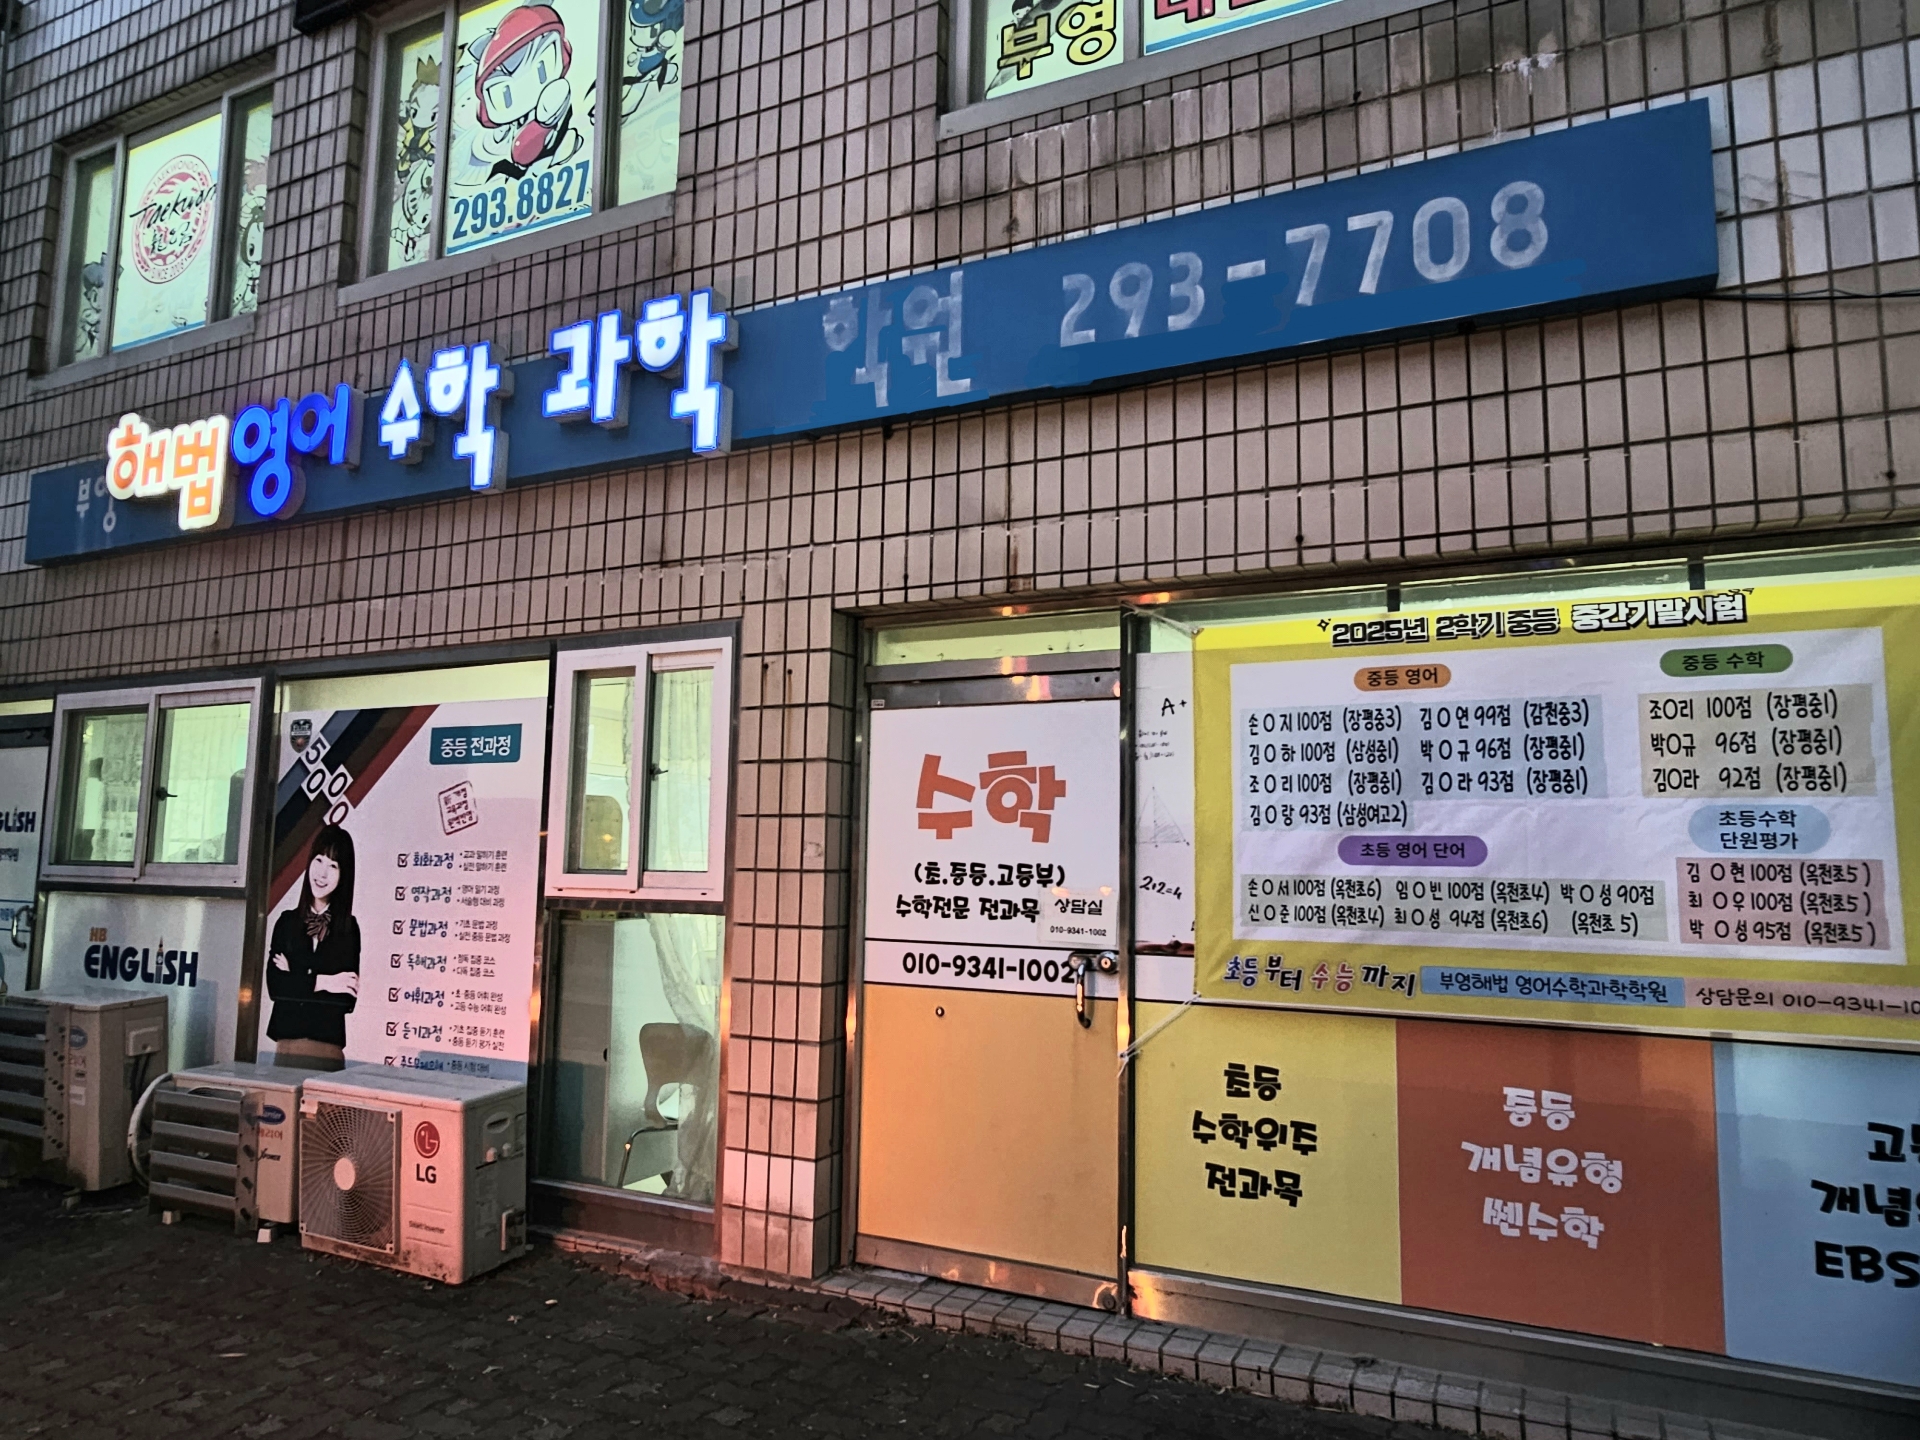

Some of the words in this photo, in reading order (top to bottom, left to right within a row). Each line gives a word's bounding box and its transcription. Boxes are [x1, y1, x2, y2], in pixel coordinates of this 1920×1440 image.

[998, 0, 1116, 81] 부영
[453, 160, 590, 240] 293.8827
[378, 341, 500, 490] 수학
[543, 288, 726, 454] 과학
[1059, 180, 1549, 349] 293-7708
[1332, 618, 1429, 647] 2025년
[1570, 593, 1748, 632] 중간기말시험
[1682, 654, 1718, 671] 중등
[1726, 651, 1765, 669] 수학
[1367, 670, 1399, 687] 중등
[1405, 668, 1438, 685] 영어
[1524, 699, 1589, 728] (감천중3)
[1707, 696, 1752, 719] 100점
[1767, 689, 1837, 721] (장평중1)
[1343, 705, 1401, 733] (장평중3)
[441, 738, 466, 758] 중등
[471, 736, 511, 757] 전과정
[1347, 737, 1399, 764] (삼성중1)
[1524, 732, 1584, 762] (장평중1)
[1715, 731, 1756, 754] 96점
[1772, 725, 1842, 756] (장평중1)
[1348, 769, 1401, 795] (장평중1)
[1527, 766, 1588, 795] (장평중1)
[1719, 767, 1761, 790] 92점
[1776, 761, 1847, 792] (장평중1)
[916, 751, 1066, 843] 수학
[1337, 800, 1407, 828] (삼성여고2)
[1719, 811, 1797, 827] 초등수학
[1361, 843, 1390, 857] 초등
[1396, 842, 1427, 858] 영어
[1433, 843, 1465, 858] 단어
[1721, 832, 1798, 849] 단원평가
[413, 852, 454, 869] 회화과정
[914, 862, 1065, 888] (초.중등.고등부)
[1331, 877, 1382, 900] (옥천초6)
[411, 886, 452, 903] 영작과정
[1491, 880, 1549, 905] (옥천초4)
[896, 895, 970, 920] 수학전문
[980, 897, 1039, 922] 전과목
[1055, 898, 1103, 916] 상담실
[1331, 904, 1384, 927] (옥천초4)
[89, 927, 107, 942] HB
[409, 919, 448, 938] 문법과정
[1050, 926, 1107, 937] 010-9341-1002
[1491, 908, 1548, 934] (옥천초6)
[84, 936, 198, 988] ENGLISH
[407, 954, 447, 973] 독해과정
[903, 952, 1075, 984] 010-9341-1002
[404, 987, 444, 1007] 어휘과정
[1440, 971, 1508, 993] 부영해법
[1516, 975, 1668, 1003] 영어수학과학학원
[1696, 987, 1773, 1006] 상담문의
[402, 1022, 442, 1042] 듣기과정
[1224, 1063, 1281, 1101] 초등
[1504, 1086, 1575, 1131] 중등
[1192, 1110, 1317, 1155] 수학위주
[1868, 1122, 1920, 1163] 고
[416, 1163, 437, 1184] LG
[1462, 1142, 1623, 1193] 개념유형
[1205, 1162, 1303, 1207] 전과목
[1811, 1179, 1920, 1228] 개념
[1483, 1197, 1604, 1249] 쎈수학
[1815, 1240, 1920, 1289] EBS
